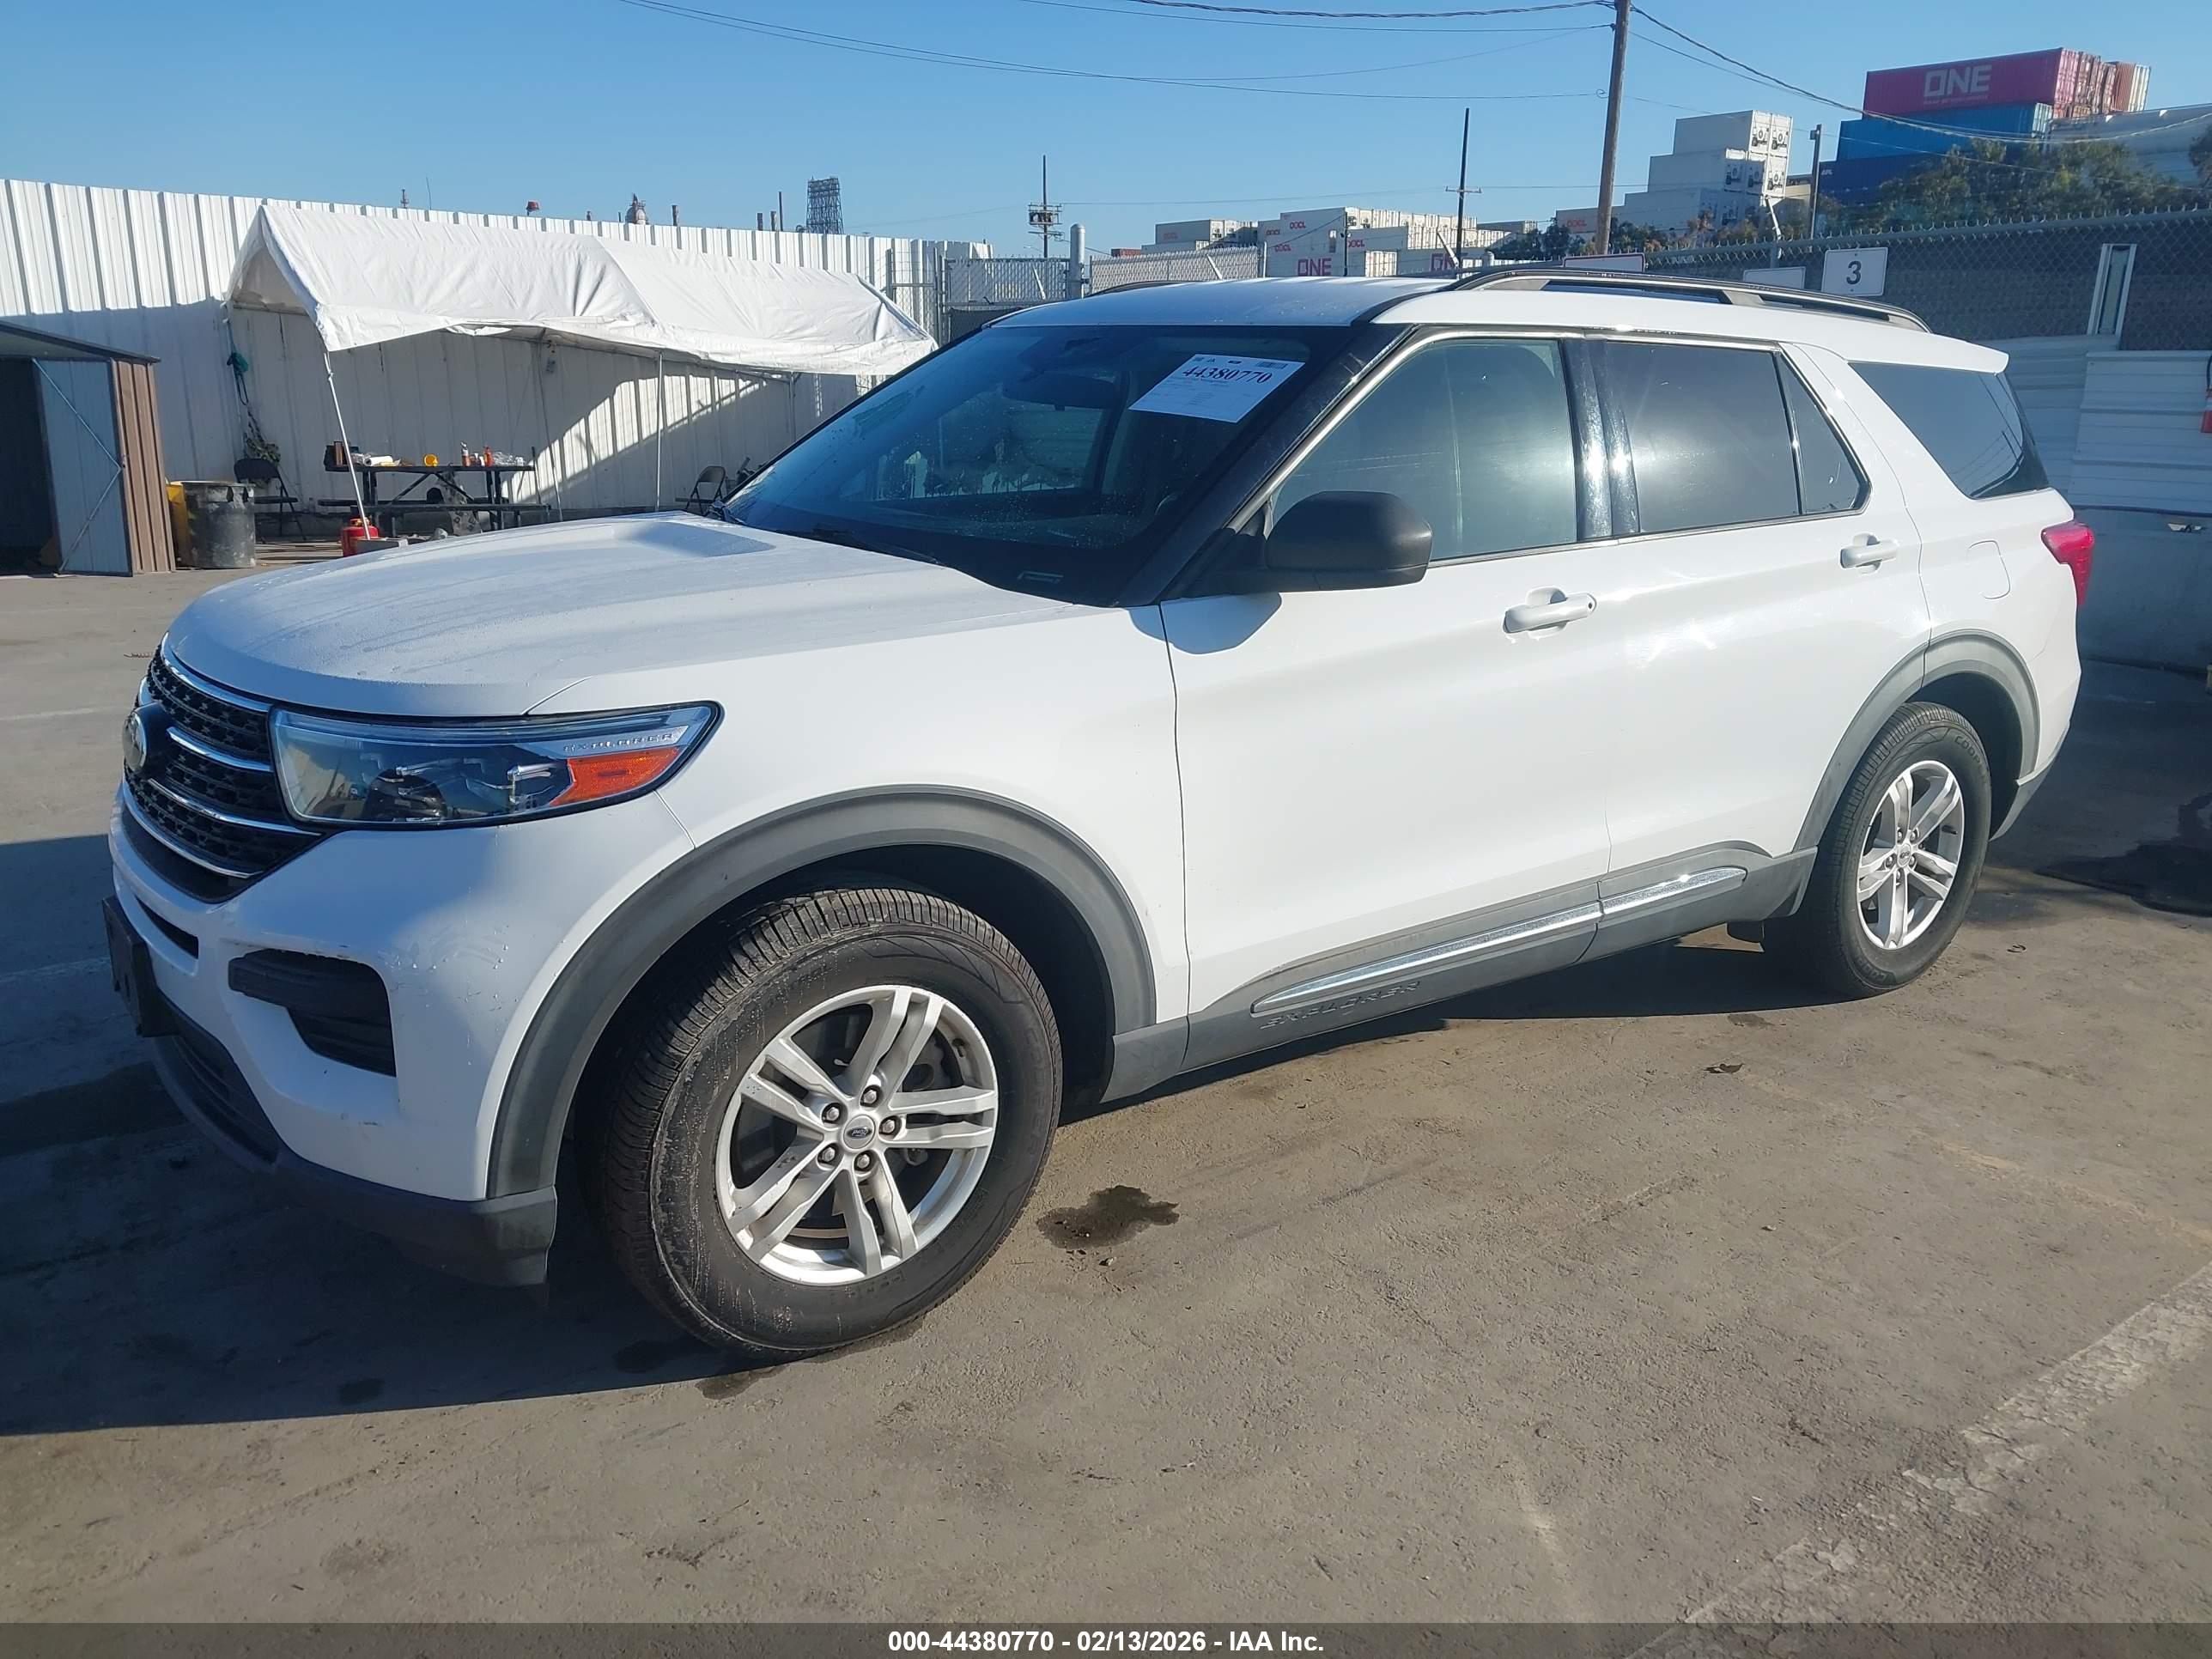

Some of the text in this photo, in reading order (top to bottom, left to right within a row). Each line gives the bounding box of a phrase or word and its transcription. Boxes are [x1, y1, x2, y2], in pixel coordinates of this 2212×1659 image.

[1923, 64, 1992, 97] ONE
[1297, 258, 1332, 276] ONE
[1846, 260, 1862, 285] 3
[1182, 366, 1273, 384] 44380770
